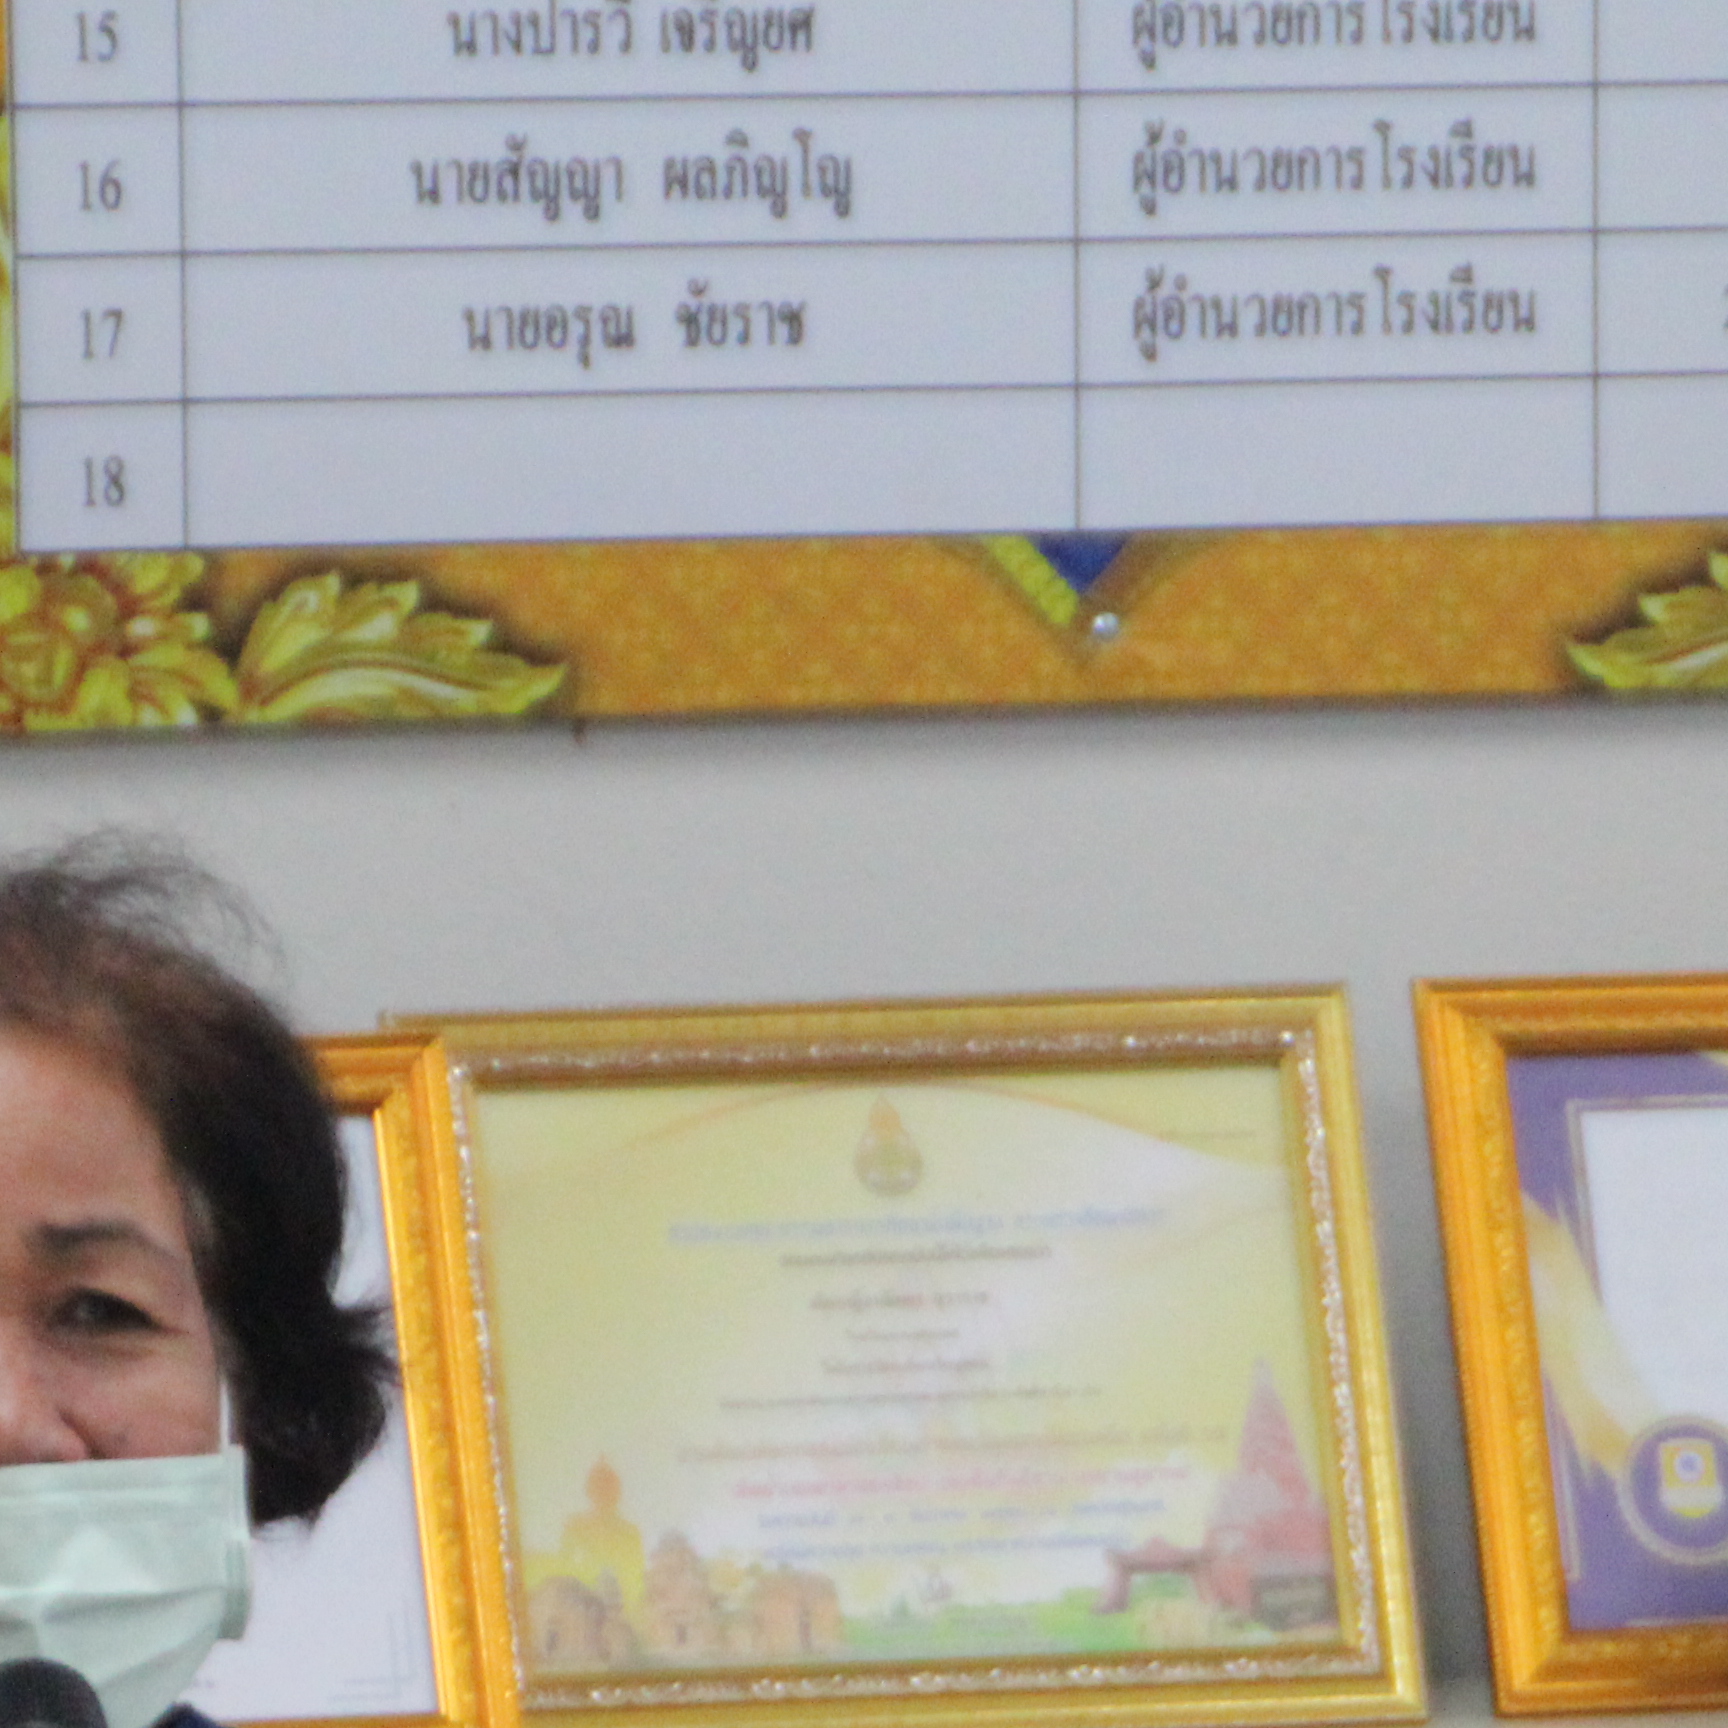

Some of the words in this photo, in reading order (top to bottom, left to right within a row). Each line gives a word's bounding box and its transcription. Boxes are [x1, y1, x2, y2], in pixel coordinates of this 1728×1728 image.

[76, 10, 119, 63] 15
[80, 157, 123, 213] 16
[410, 131, 625, 222] นายสัญญา
[662, 126, 855, 220] ผลภิญโญ
[1131, 117, 1538, 218] ผู้อำนวยการโรงเรียน
[81, 308, 125, 361] 17
[462, 303, 636, 370] นายอรุณ
[675, 276, 809, 348] ชัยราช
[1131, 262, 1538, 363] ผู้อำนวยการโรงเรียน
[84, 455, 127, 508] 18
